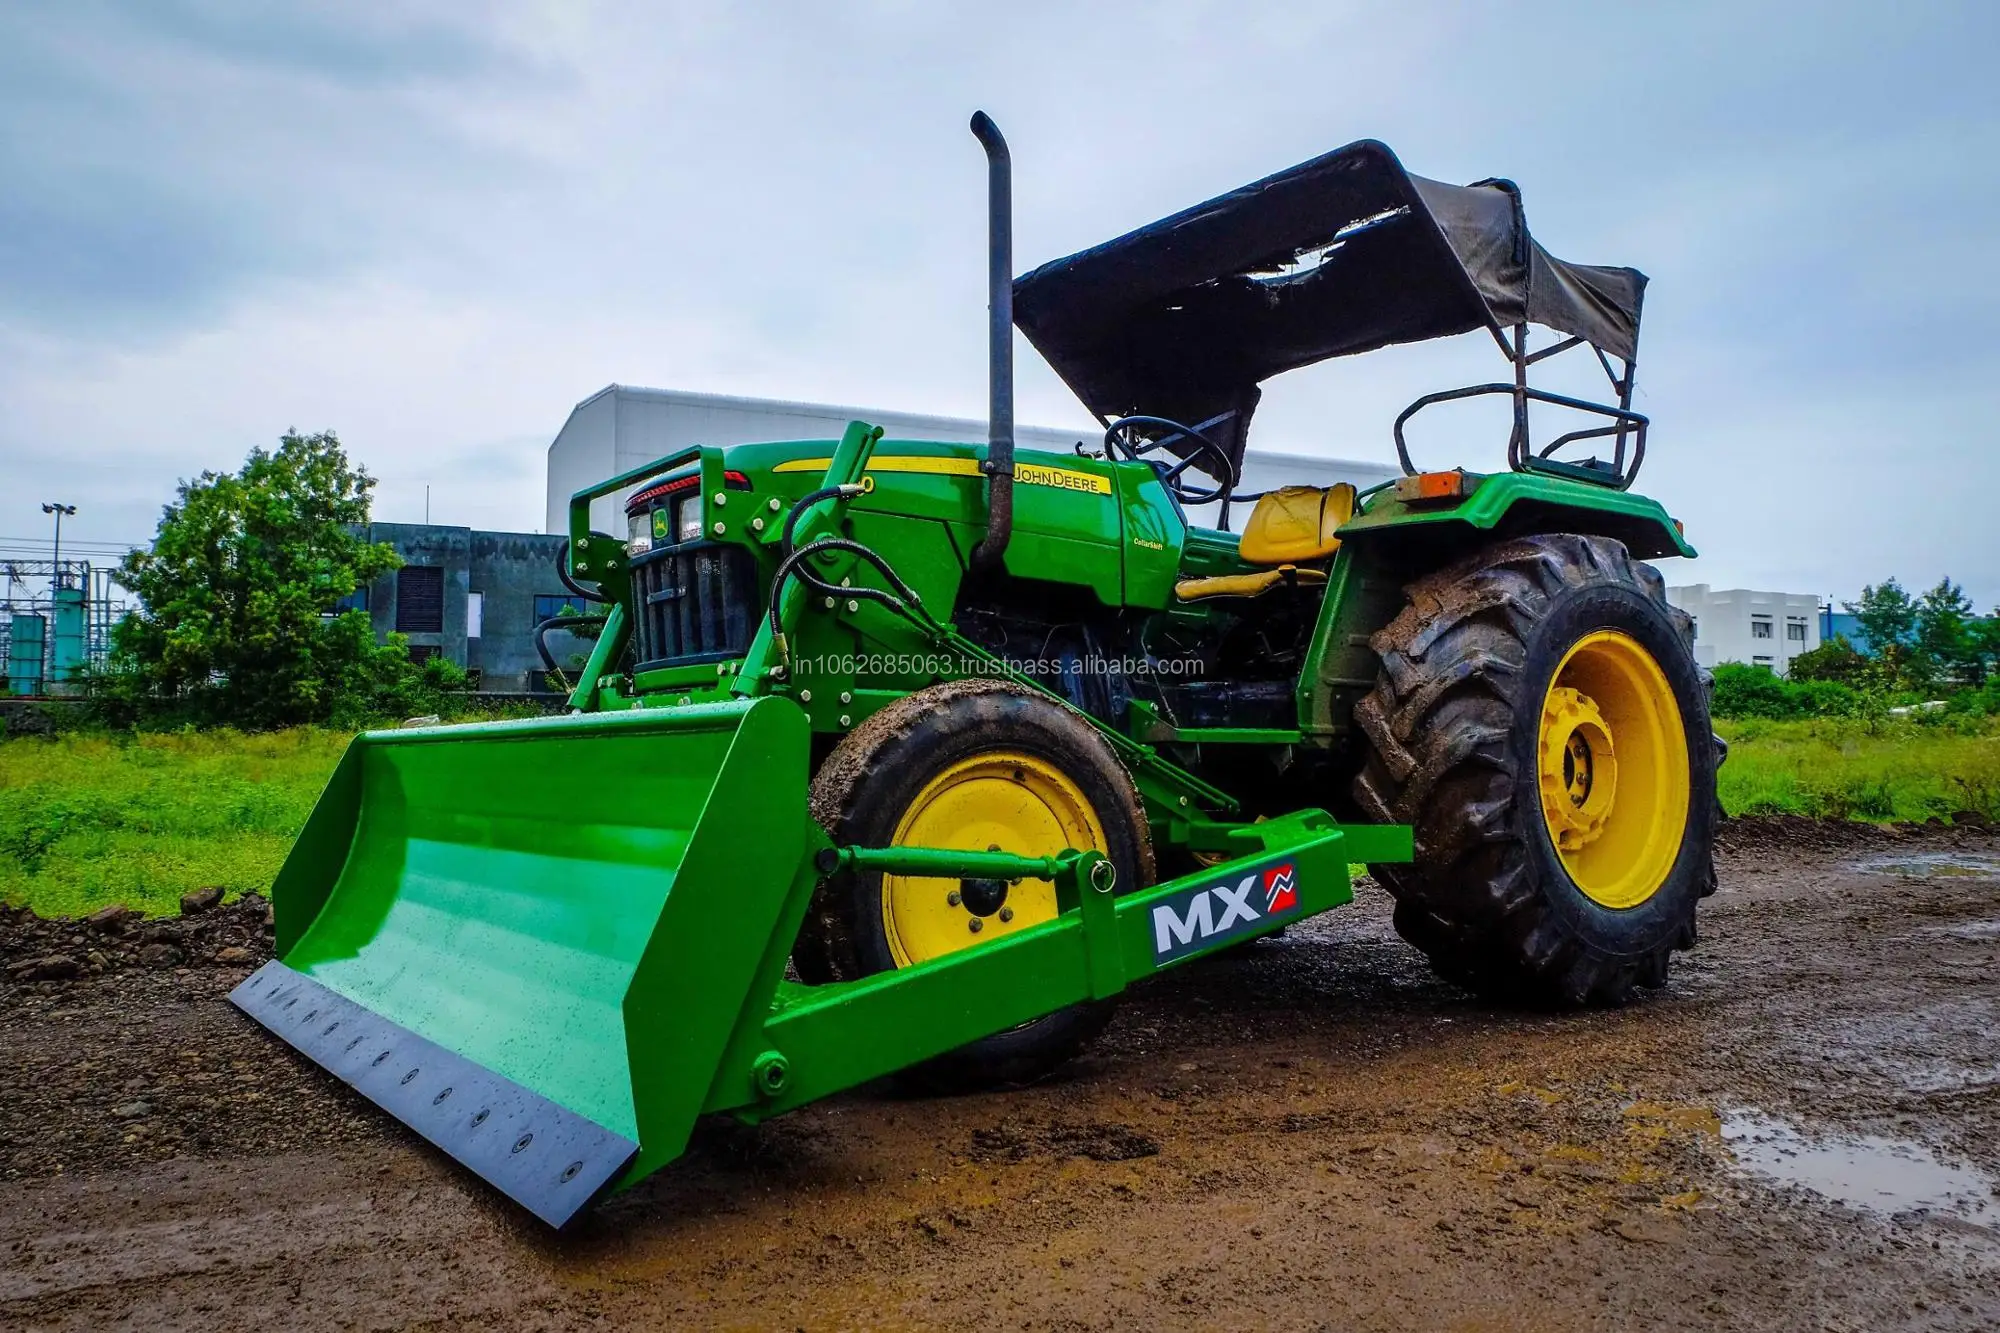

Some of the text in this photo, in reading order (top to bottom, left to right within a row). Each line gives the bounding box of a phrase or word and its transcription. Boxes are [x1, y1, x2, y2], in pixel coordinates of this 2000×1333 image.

[1014, 466, 1099, 491] JOHN DEERE
[1152, 874, 1262, 954] MX
